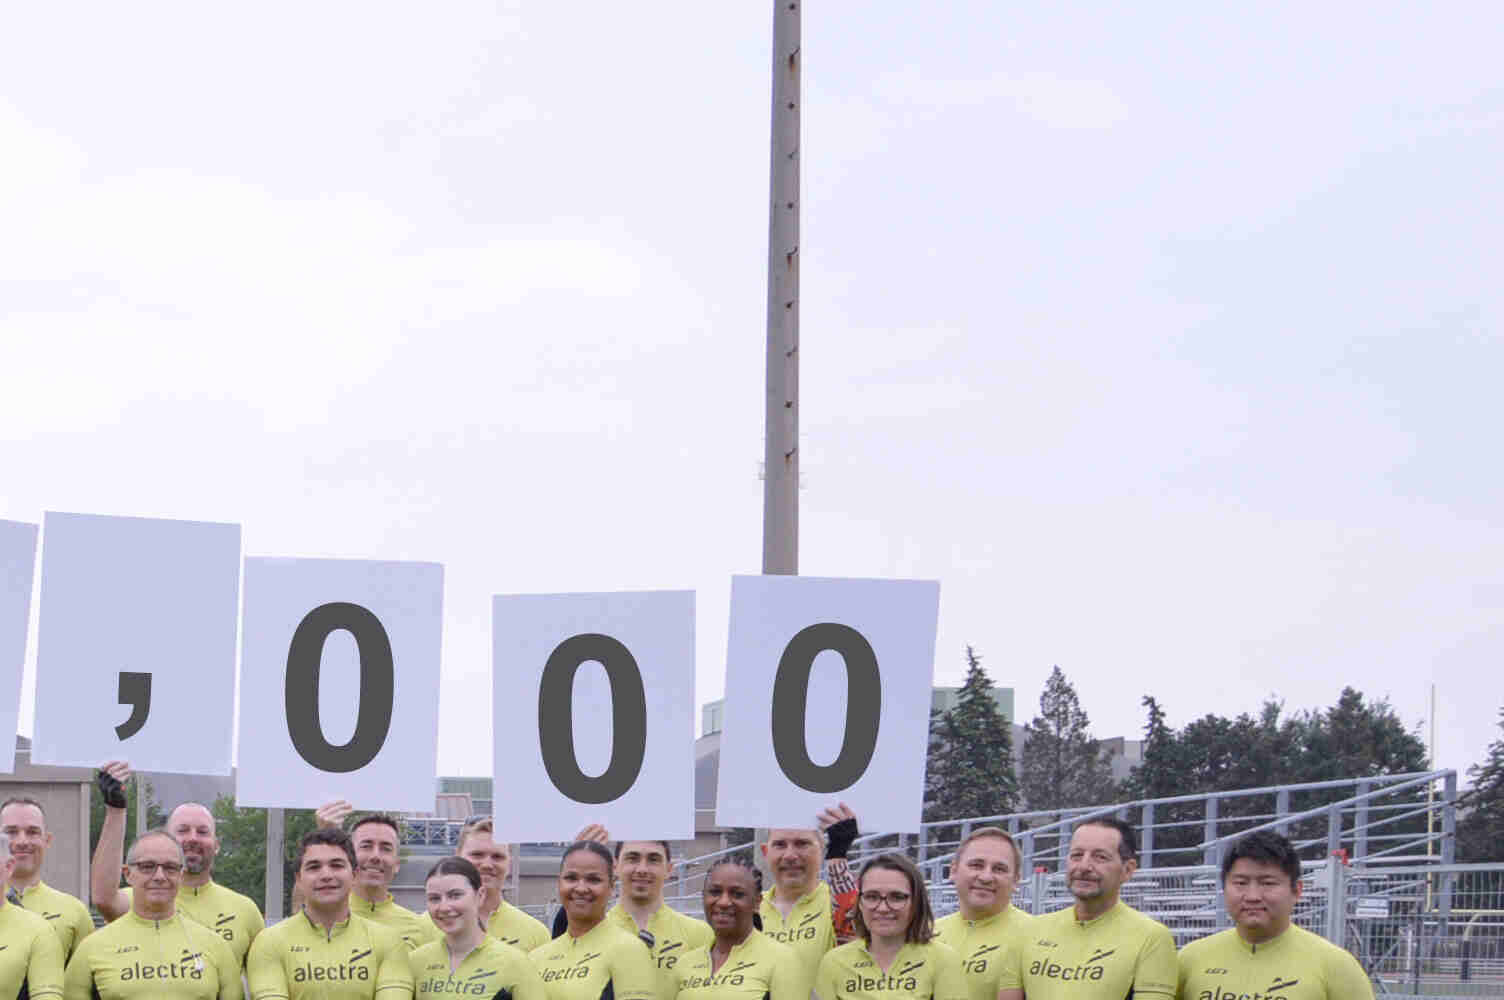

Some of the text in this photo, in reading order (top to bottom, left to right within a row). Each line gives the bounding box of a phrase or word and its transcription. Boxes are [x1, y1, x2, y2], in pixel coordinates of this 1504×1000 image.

[120, 961, 203, 982] alectra
[294, 961, 369, 983] alectra
[1029, 957, 1104, 981] alectra
[420, 976, 487, 996] alectra
[845, 974, 917, 993] alectra
